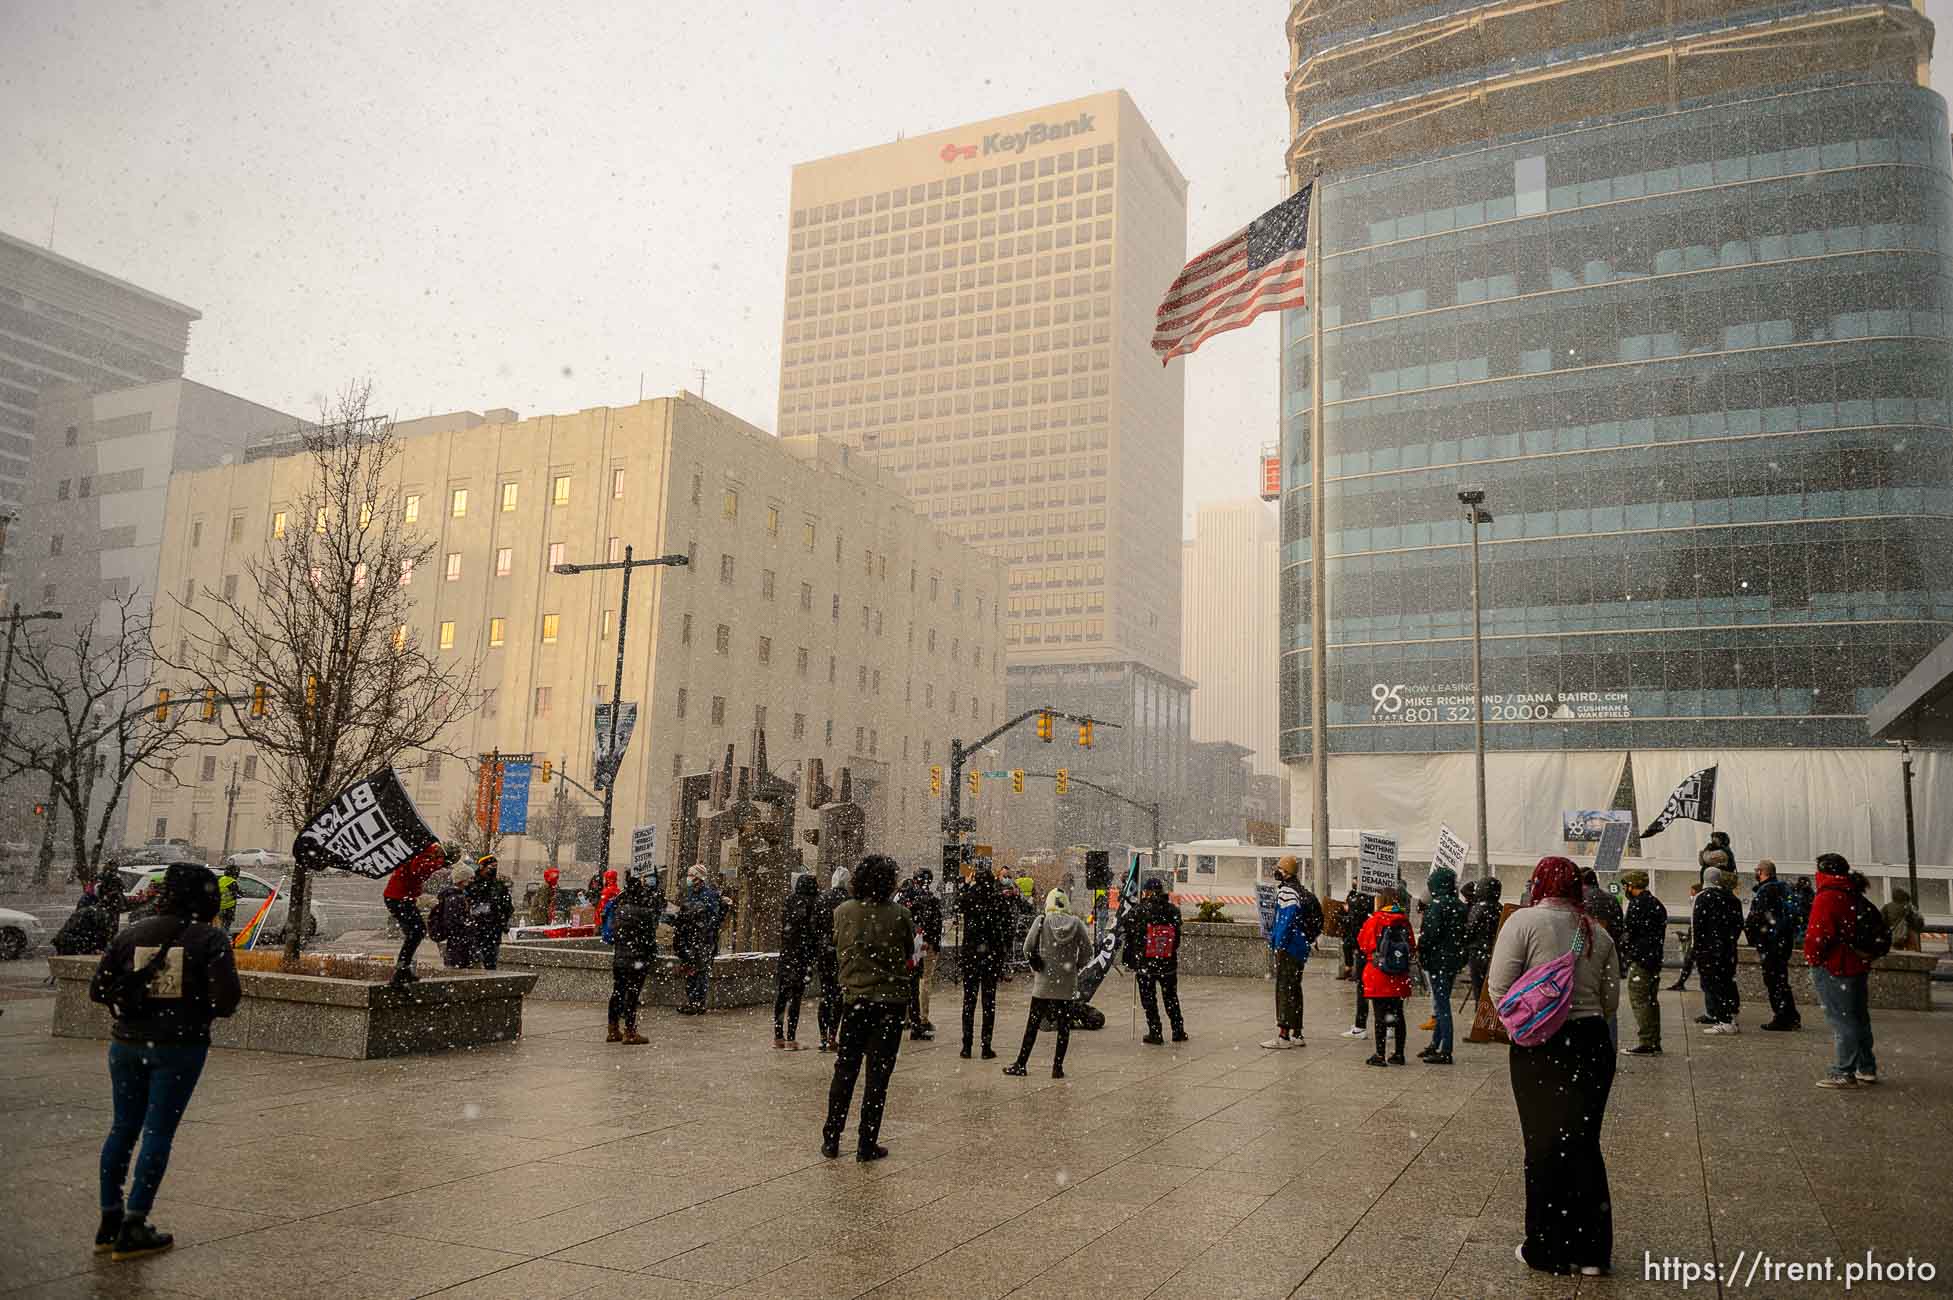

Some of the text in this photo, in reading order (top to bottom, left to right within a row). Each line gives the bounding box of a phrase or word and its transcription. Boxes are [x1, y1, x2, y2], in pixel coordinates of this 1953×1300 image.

[984, 112, 1097, 155] KeyBank
[1371, 683, 1405, 714] 95
[1405, 696, 1433, 706] MIKE
[1437, 695, 1503, 705] RICHMND
[1517, 693, 1554, 703] DANA
[1405, 707, 1438, 722] 801
[1491, 704, 1548, 720] 2000
[1364, 843, 1394, 854] NOTHING
[1372, 870, 1395, 879] PEOPLE
[1610, 884, 1618, 893] B
